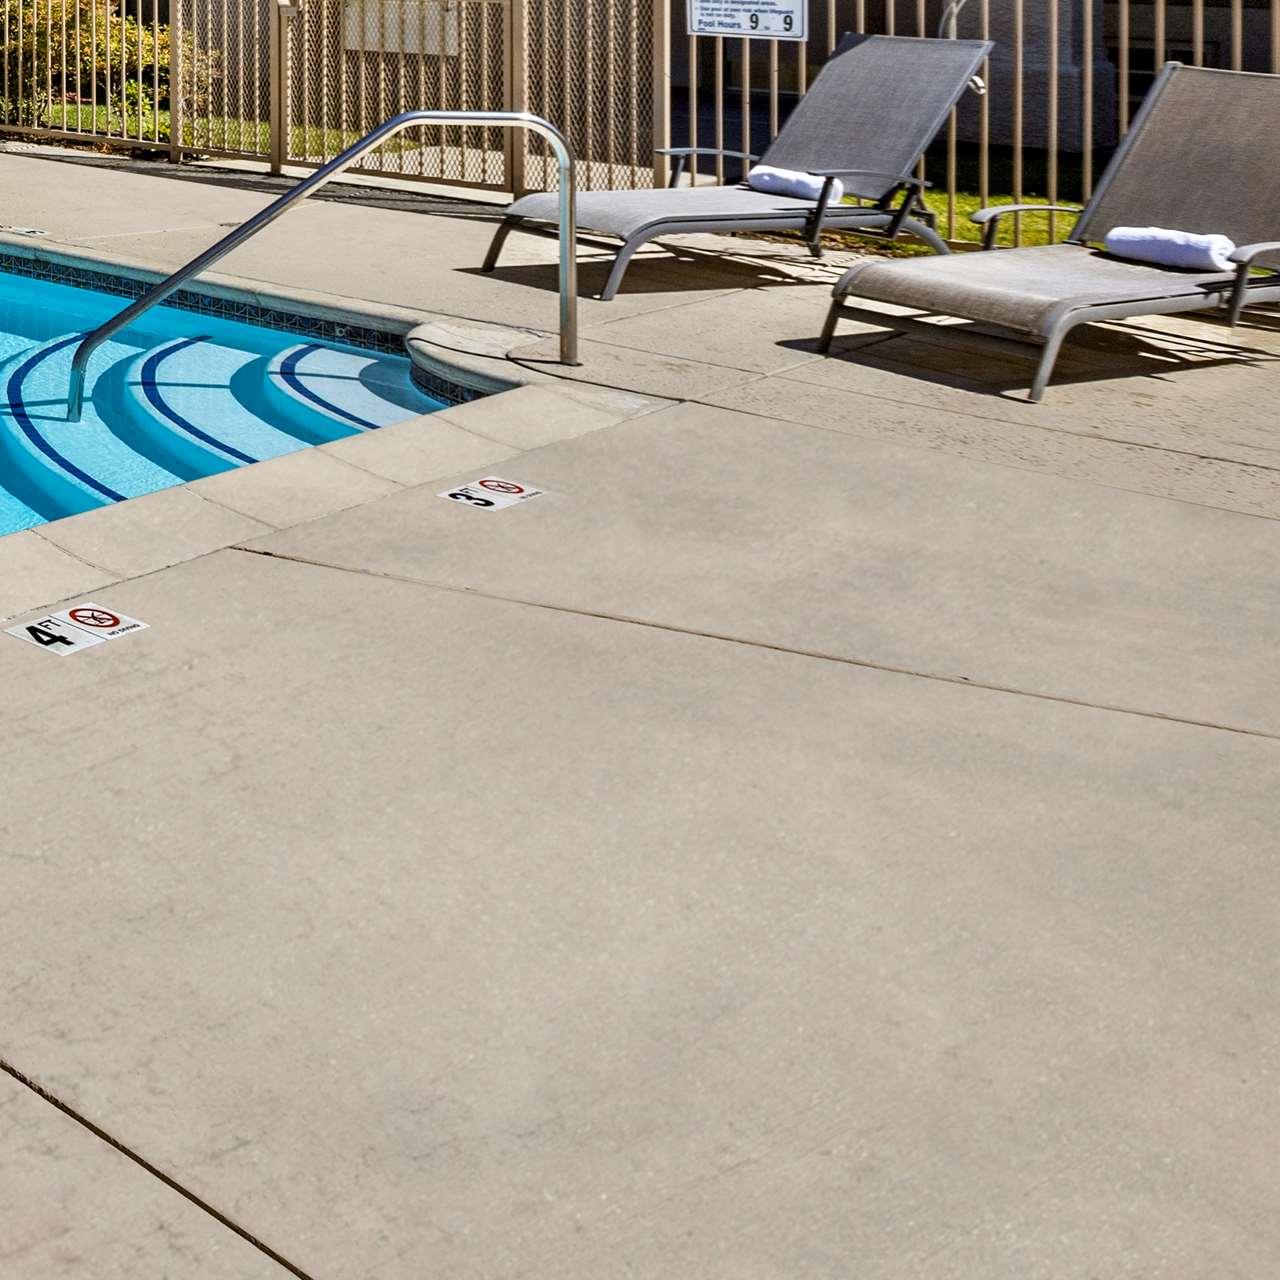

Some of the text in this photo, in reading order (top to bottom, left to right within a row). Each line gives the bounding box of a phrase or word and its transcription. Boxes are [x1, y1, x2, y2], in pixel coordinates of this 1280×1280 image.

[698, 19, 715, 27] Pool
[718, 20, 741, 28] Hours
[750, 13, 759, 30] 9
[784, 15, 793, 31] 9
[448, 493, 495, 507] 3
[25, 619, 74, 646] 4 FT
